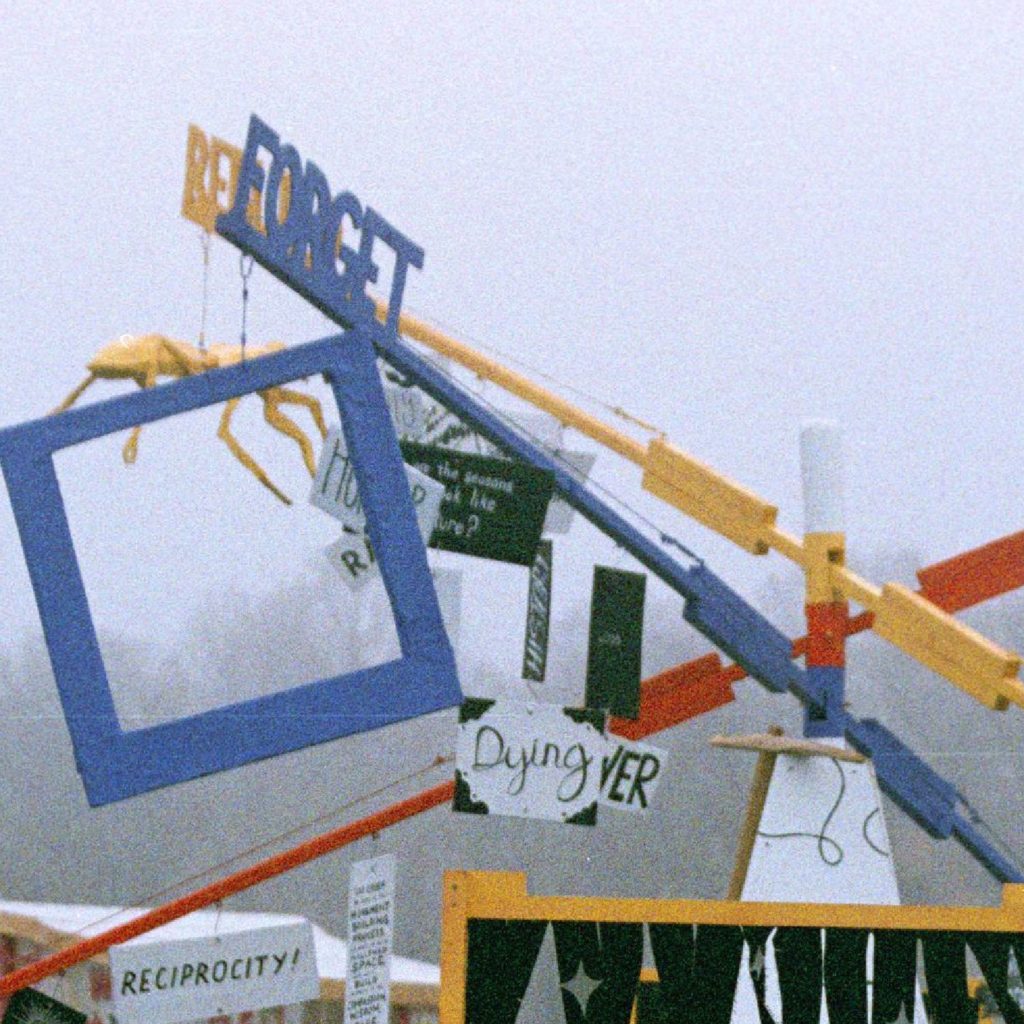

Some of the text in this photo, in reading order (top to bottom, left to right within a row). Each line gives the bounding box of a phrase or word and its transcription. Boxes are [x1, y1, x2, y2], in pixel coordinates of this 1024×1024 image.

[222, 113, 425, 333] FORGET
[471, 725, 593, 802] Dying
[120, 948, 302, 996] RECIPROCITY!
